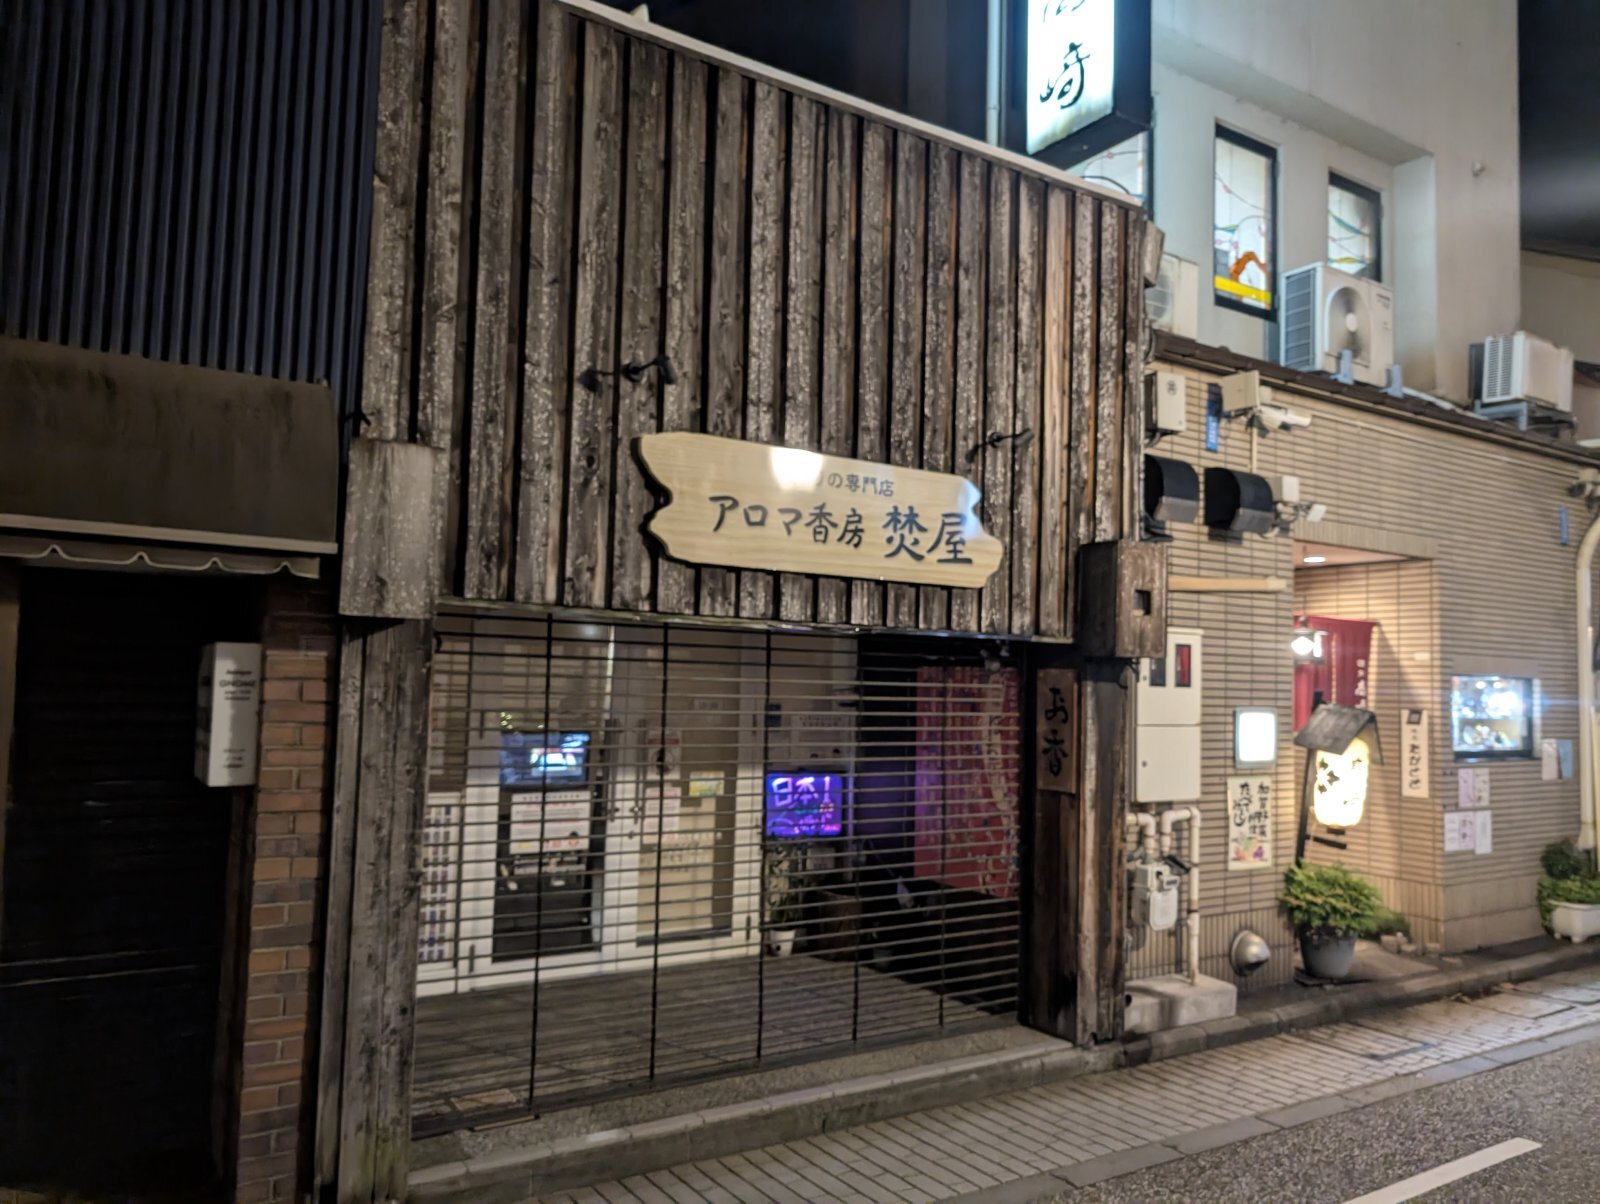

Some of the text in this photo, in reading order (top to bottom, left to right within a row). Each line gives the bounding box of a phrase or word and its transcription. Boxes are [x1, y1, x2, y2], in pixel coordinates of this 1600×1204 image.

[708, 495, 973, 566] アロマ香房 焚屋
[1042, 686, 1069, 777] お香
